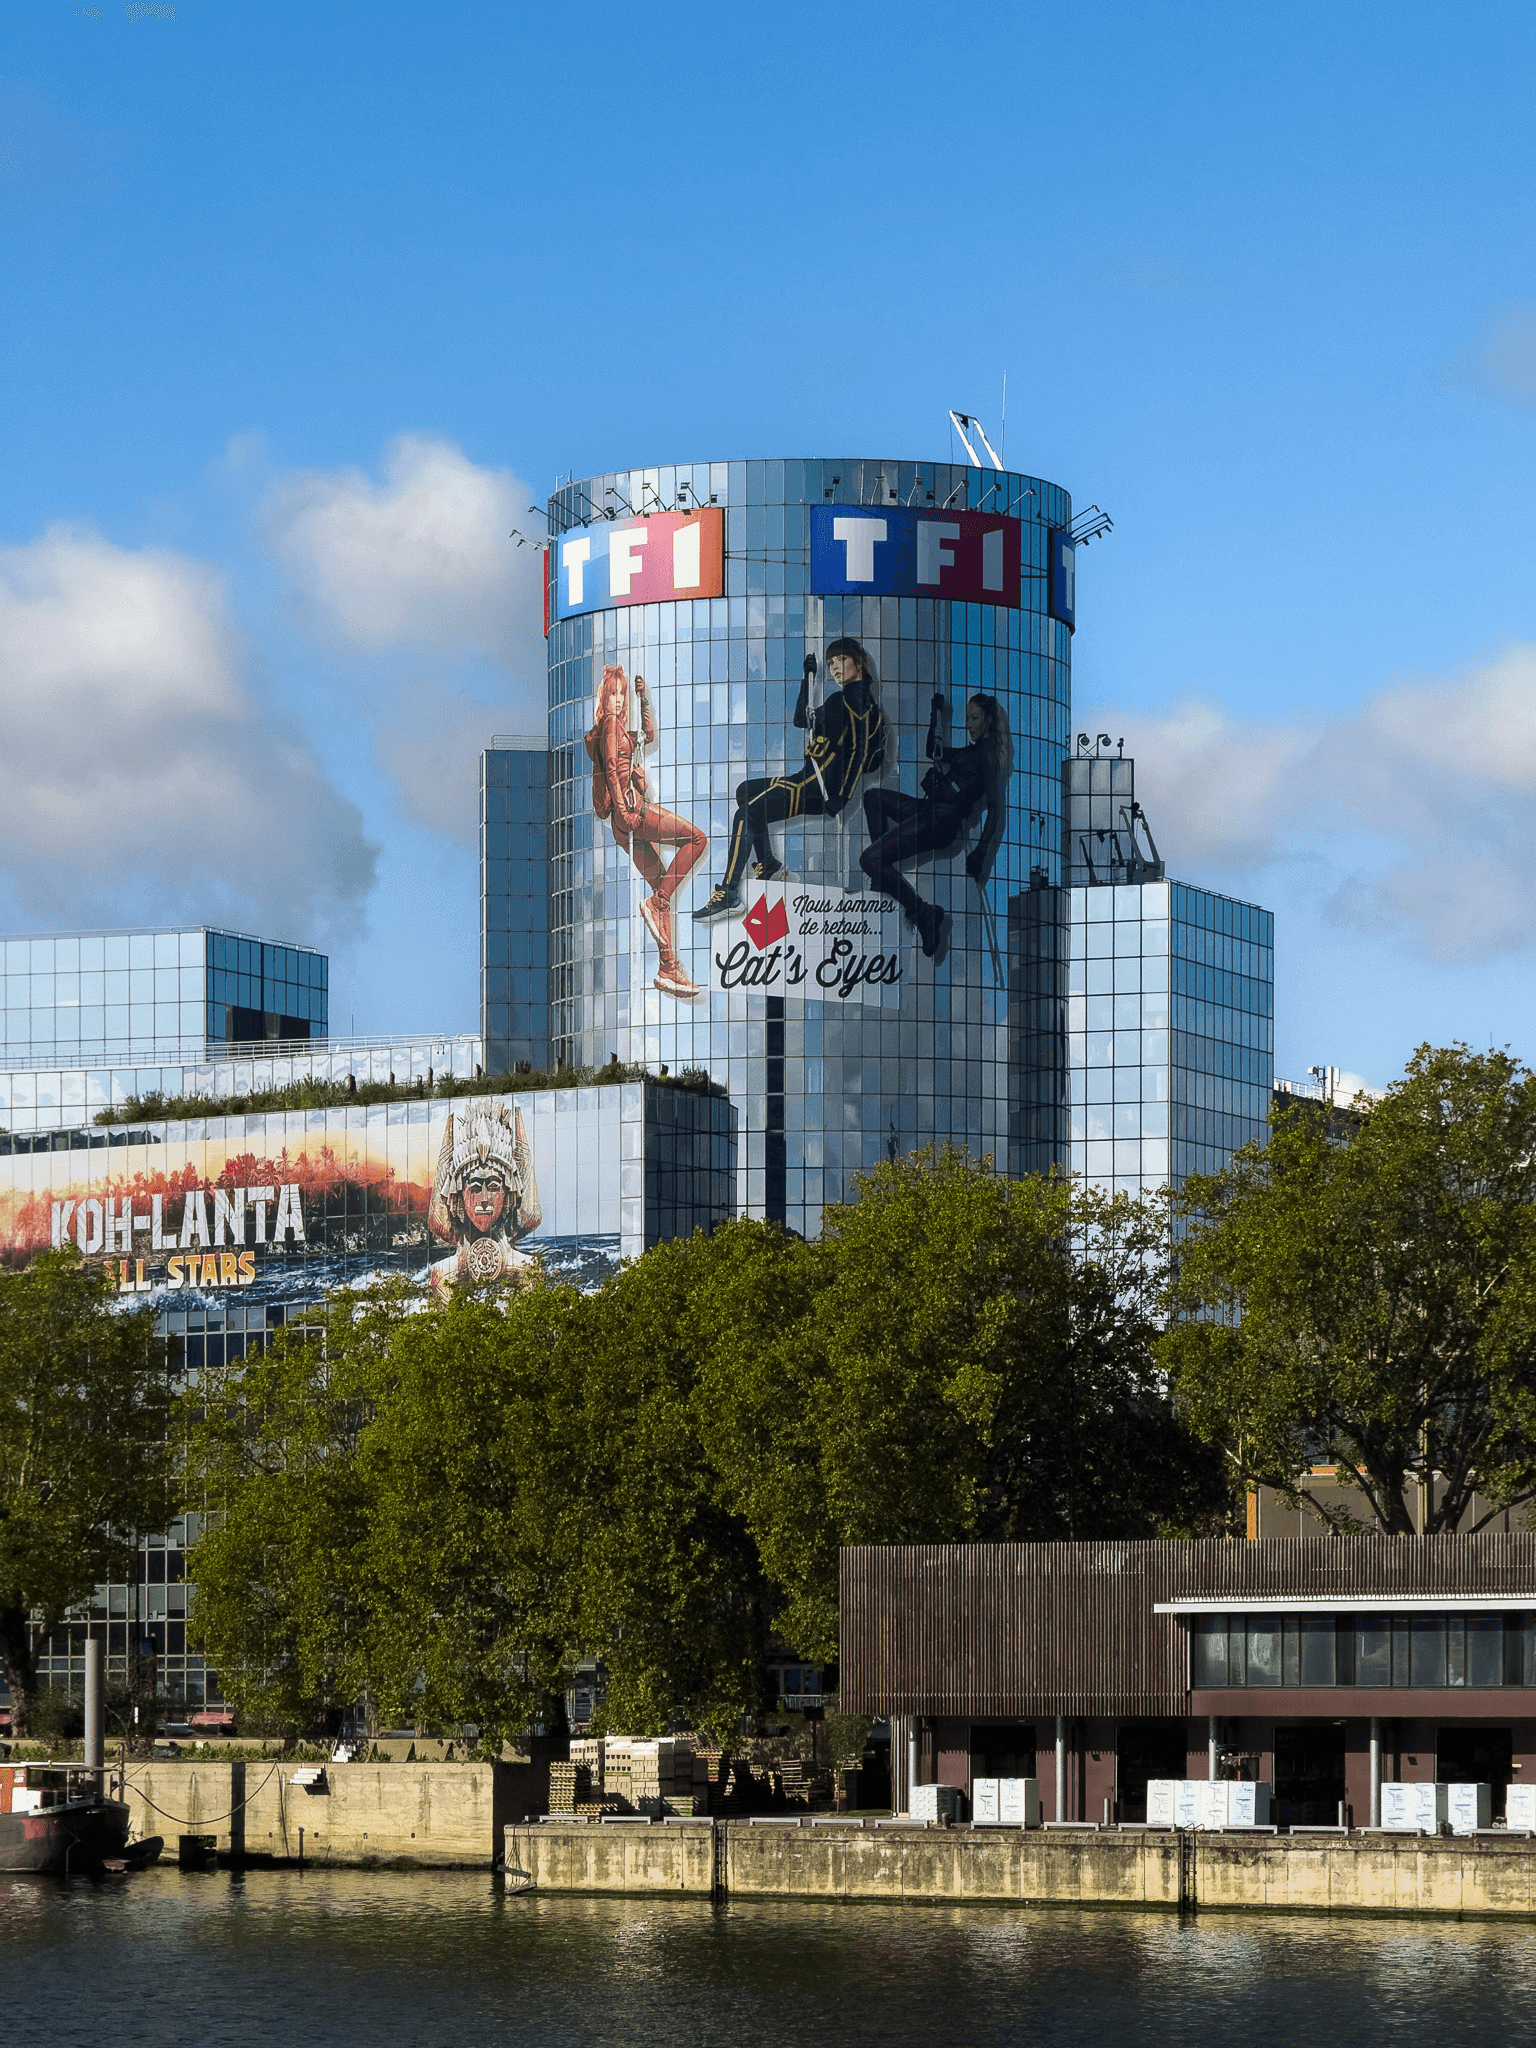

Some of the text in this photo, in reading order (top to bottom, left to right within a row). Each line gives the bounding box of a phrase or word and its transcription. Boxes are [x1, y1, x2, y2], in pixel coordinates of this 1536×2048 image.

[563, 521, 700, 606] TF1
[833, 516, 1004, 592] TF1
[793, 894, 896, 916] Nous sommes
[799, 917, 883, 936] de retour...
[715, 936, 903, 998] Cat's Eyes
[50, 1184, 306, 1254] KOH-LANTA
[167, 1251, 256, 1290] STARS
